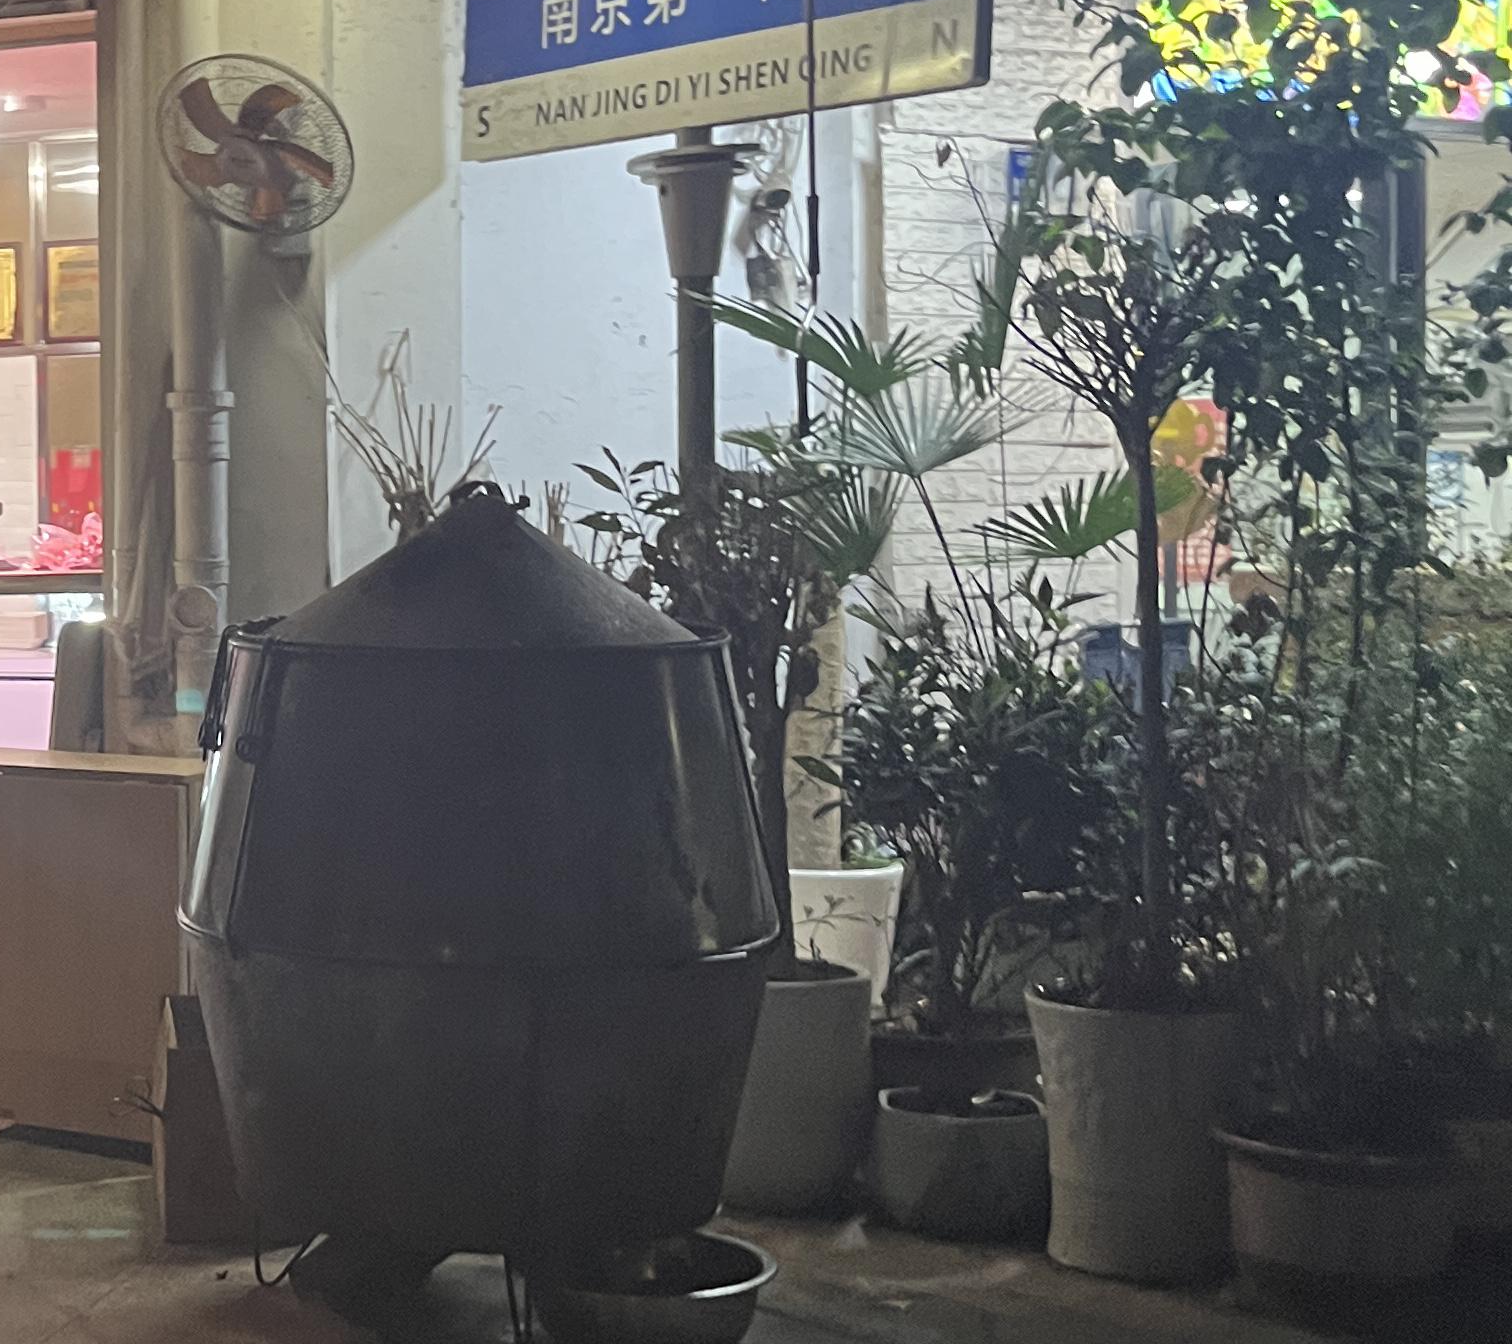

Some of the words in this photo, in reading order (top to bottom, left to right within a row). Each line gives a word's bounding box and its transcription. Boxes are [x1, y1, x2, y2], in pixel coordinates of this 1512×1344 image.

[931, 19, 959, 59] N
[655, 77, 680, 106] DI
[688, 72, 710, 100] YI
[718, 58, 789, 96] SHEN
[477, 106, 491, 138] S
